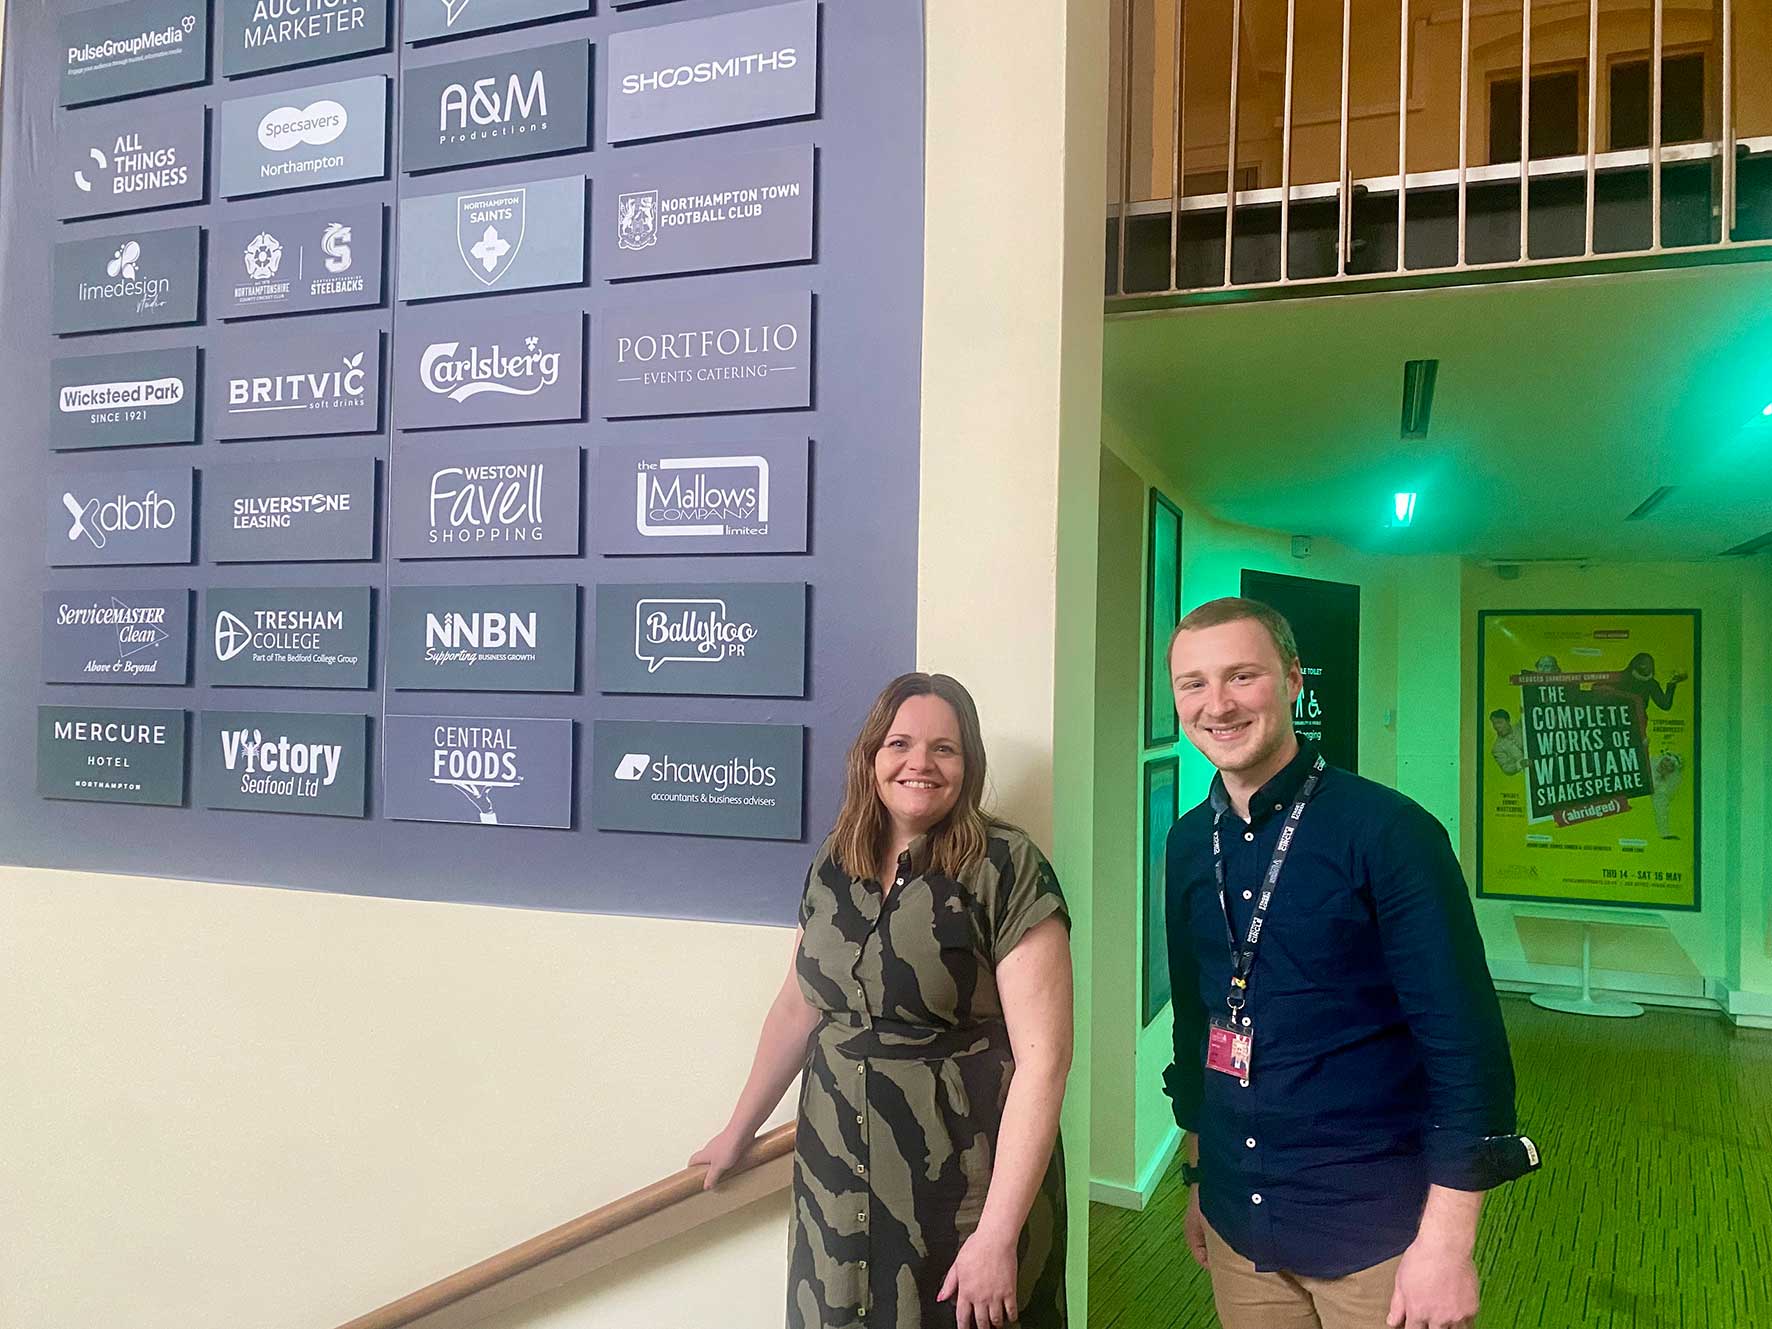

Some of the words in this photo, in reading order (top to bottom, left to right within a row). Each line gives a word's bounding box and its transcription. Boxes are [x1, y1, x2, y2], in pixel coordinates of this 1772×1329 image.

[253, 0, 358, 22] AUCT
[244, 7, 366, 48] MARKETER
[68, 26, 183, 64] PulseGroupMedia
[622, 48, 797, 95] SHOOSMITHS
[440, 70, 548, 131] A&M
[265, 114, 340, 138] Specsavers
[440, 121, 548, 145] Productions
[114, 133, 142, 154] ALL
[114, 148, 176, 174] THINGS
[261, 155, 344, 178] Northampton
[113, 166, 188, 194] BUSINESS
[463, 196, 519, 211] NORTHAMPTON
[661, 188, 758, 213] NORTHAMPTON
[761, 183, 800, 200] TOWN
[470, 208, 513, 224] SAINTS
[661, 207, 725, 228] FOOTBALL
[729, 203, 762, 219] CLUB
[79, 276, 169, 301] limedesign
[234, 282, 291, 298] NORTHAMPTONSHIRE
[310, 279, 364, 296] STEELBACKS
[136, 293, 167, 314] studio
[617, 323, 798, 363] PORTFOLIO
[420, 337, 561, 401] Carlsberg
[643, 369, 693, 385] EVENTS
[697, 363, 768, 381] CATERING
[64, 383, 141, 407] Wicksteed
[145, 380, 179, 401] Park
[229, 367, 366, 405] BRITVIC
[309, 399, 329, 409] soft
[333, 398, 366, 408] drinks
[90, 412, 120, 424] SINCE
[125, 410, 147, 422] 1921
[464, 464, 528, 481] WESTON
[637, 460, 658, 471] the
[430, 463, 543, 528] Favell
[649, 474, 756, 509] Mallows
[100, 489, 176, 531] dbfb
[233, 493, 350, 515] SILVERSTONE
[649, 506, 756, 521] COMPANY
[233, 515, 291, 529] LEASING
[725, 524, 769, 536] limited
[428, 526, 543, 543] SHOPPING
[57, 603, 166, 626] ServiceMASTER
[254, 610, 344, 630] TRESHAM
[119, 624, 156, 643] Clean
[253, 632, 320, 650] COLLEGE
[425, 611, 537, 648] NNBN
[646, 610, 758, 654] Ballyhoo
[252, 653, 265, 662] Part
[266, 653, 274, 662] of
[274, 654, 286, 663] The
[287, 653, 311, 664] Bedford
[312, 655, 335, 665] College
[337, 656, 358, 666] Group
[424, 646, 478, 666] Supporting
[478, 653, 507, 662] BUSINESS
[507, 654, 536, 662] GROWTH
[728, 643, 745, 657] PR
[83, 659, 112, 673] Above
[112, 659, 121, 672] &
[123, 660, 157, 675] Beyond
[1538, 686, 1566, 703] THE
[1532, 705, 1632, 731] COMPLETE
[54, 721, 167, 745] MERCURE
[433, 725, 518, 750] CENTRAL
[1537, 728, 1604, 756] WORKS
[1612, 731, 1631, 748] OF
[87, 755, 130, 768] HOTEL
[221, 729, 342, 786] Victory
[433, 749, 518, 782] FOODS
[1534, 748, 1640, 786] WILLIAM
[651, 755, 777, 792] shawgibbs
[75, 780, 141, 791] NORTHAMPTON
[240, 773, 295, 797] Seafood
[297, 777, 319, 798] Ltd
[1536, 773, 1643, 807] SHAKESPEARE
[651, 792, 699, 804] accountants
[700, 794, 708, 804] &
[708, 794, 742, 806] business
[743, 796, 776, 807] advisers
[1562, 800, 1621, 824] (abridged)
[1602, 868, 1617, 878] THU
[1619, 869, 1628, 879] 14
[1637, 870, 1651, 880] SAT
[1665, 872, 1682, 881] MAY
